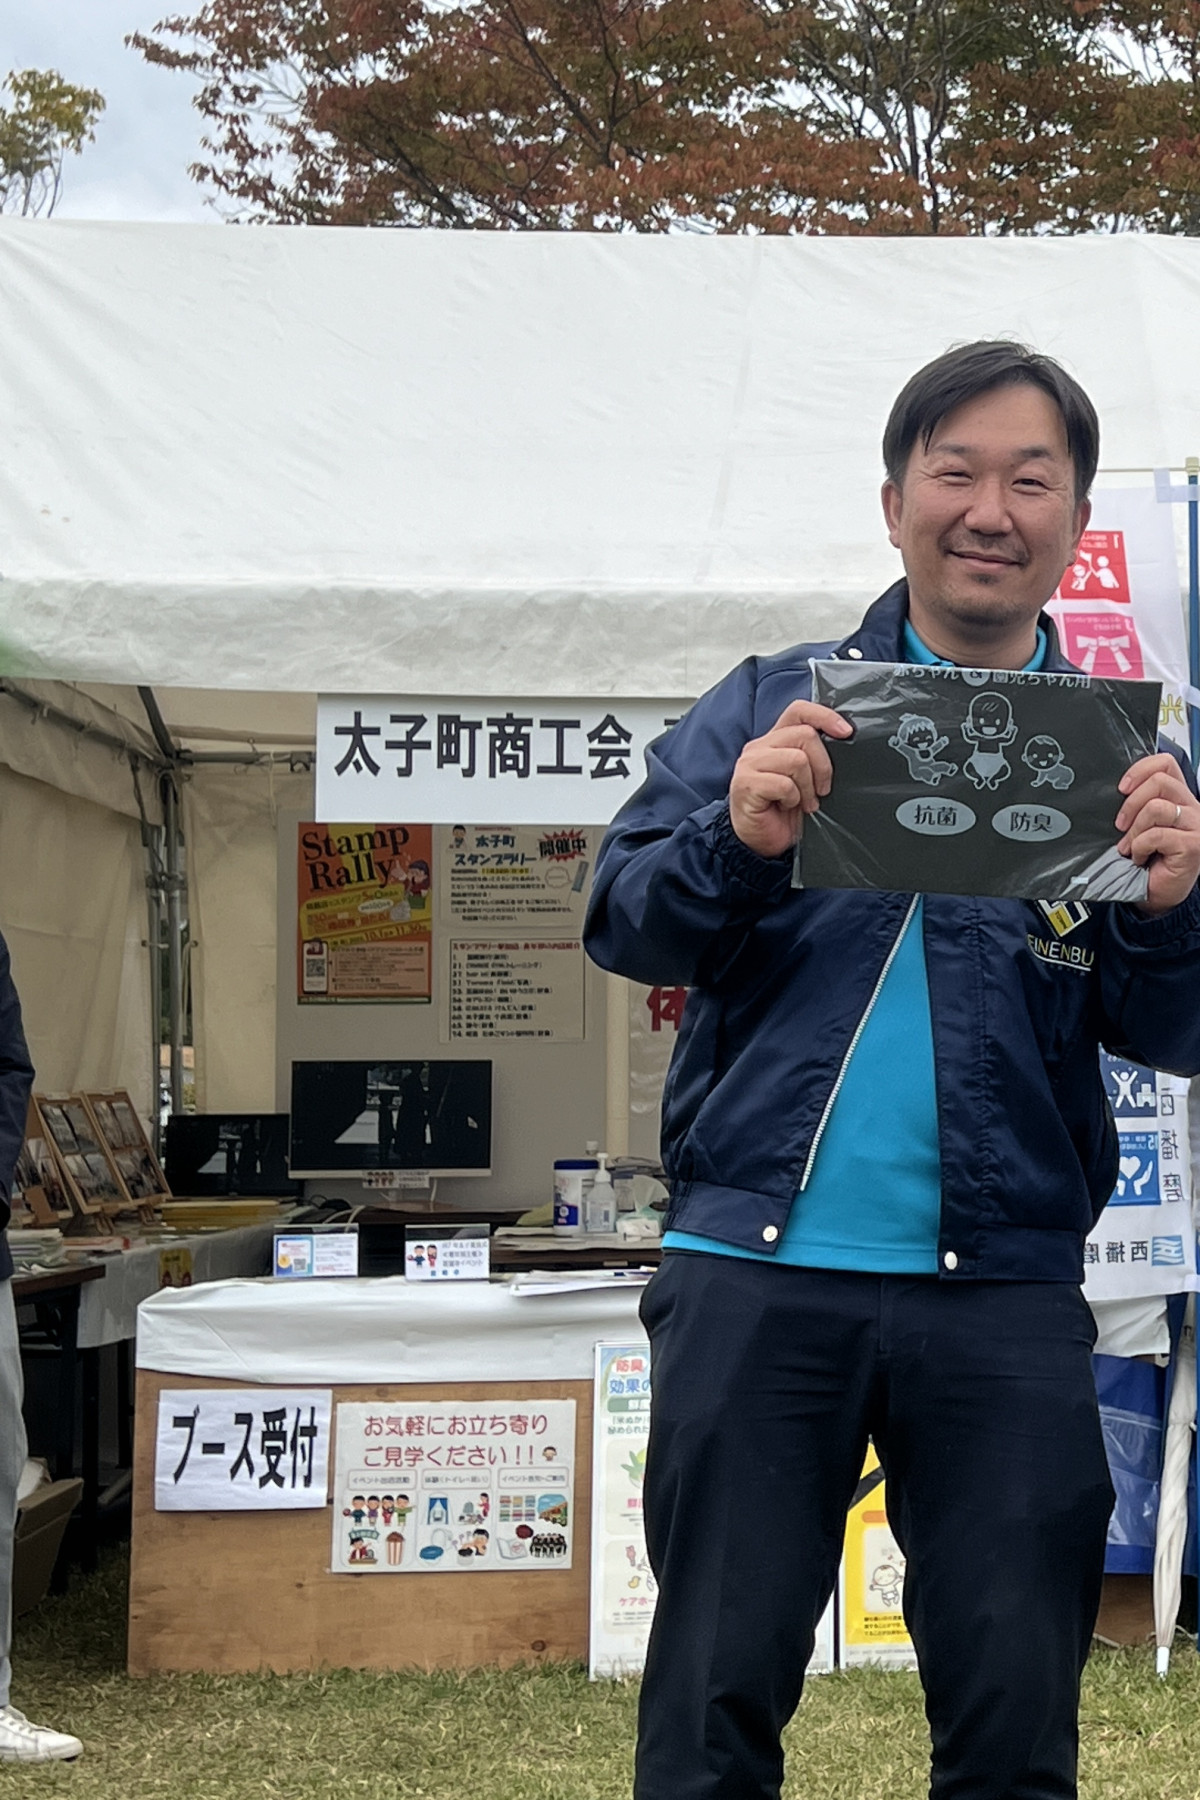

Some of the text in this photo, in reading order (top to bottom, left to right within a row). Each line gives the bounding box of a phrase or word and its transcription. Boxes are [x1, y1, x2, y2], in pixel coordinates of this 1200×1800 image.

[334, 711, 633, 779] 太子町商工会
[914, 804, 958, 827] 抗菌
[1009, 811, 1053, 834] 防臭
[302, 826, 410, 860] Stamp
[475, 835, 516, 848] 太子町
[308, 852, 394, 891] Rally
[454, 853, 537, 866] スタンプラリー
[363, 1414, 548, 1438] お気軽にお立ち寄り
[172, 1405, 318, 1489] ブース受付
[362, 1444, 535, 1468] ご見学ください！！
